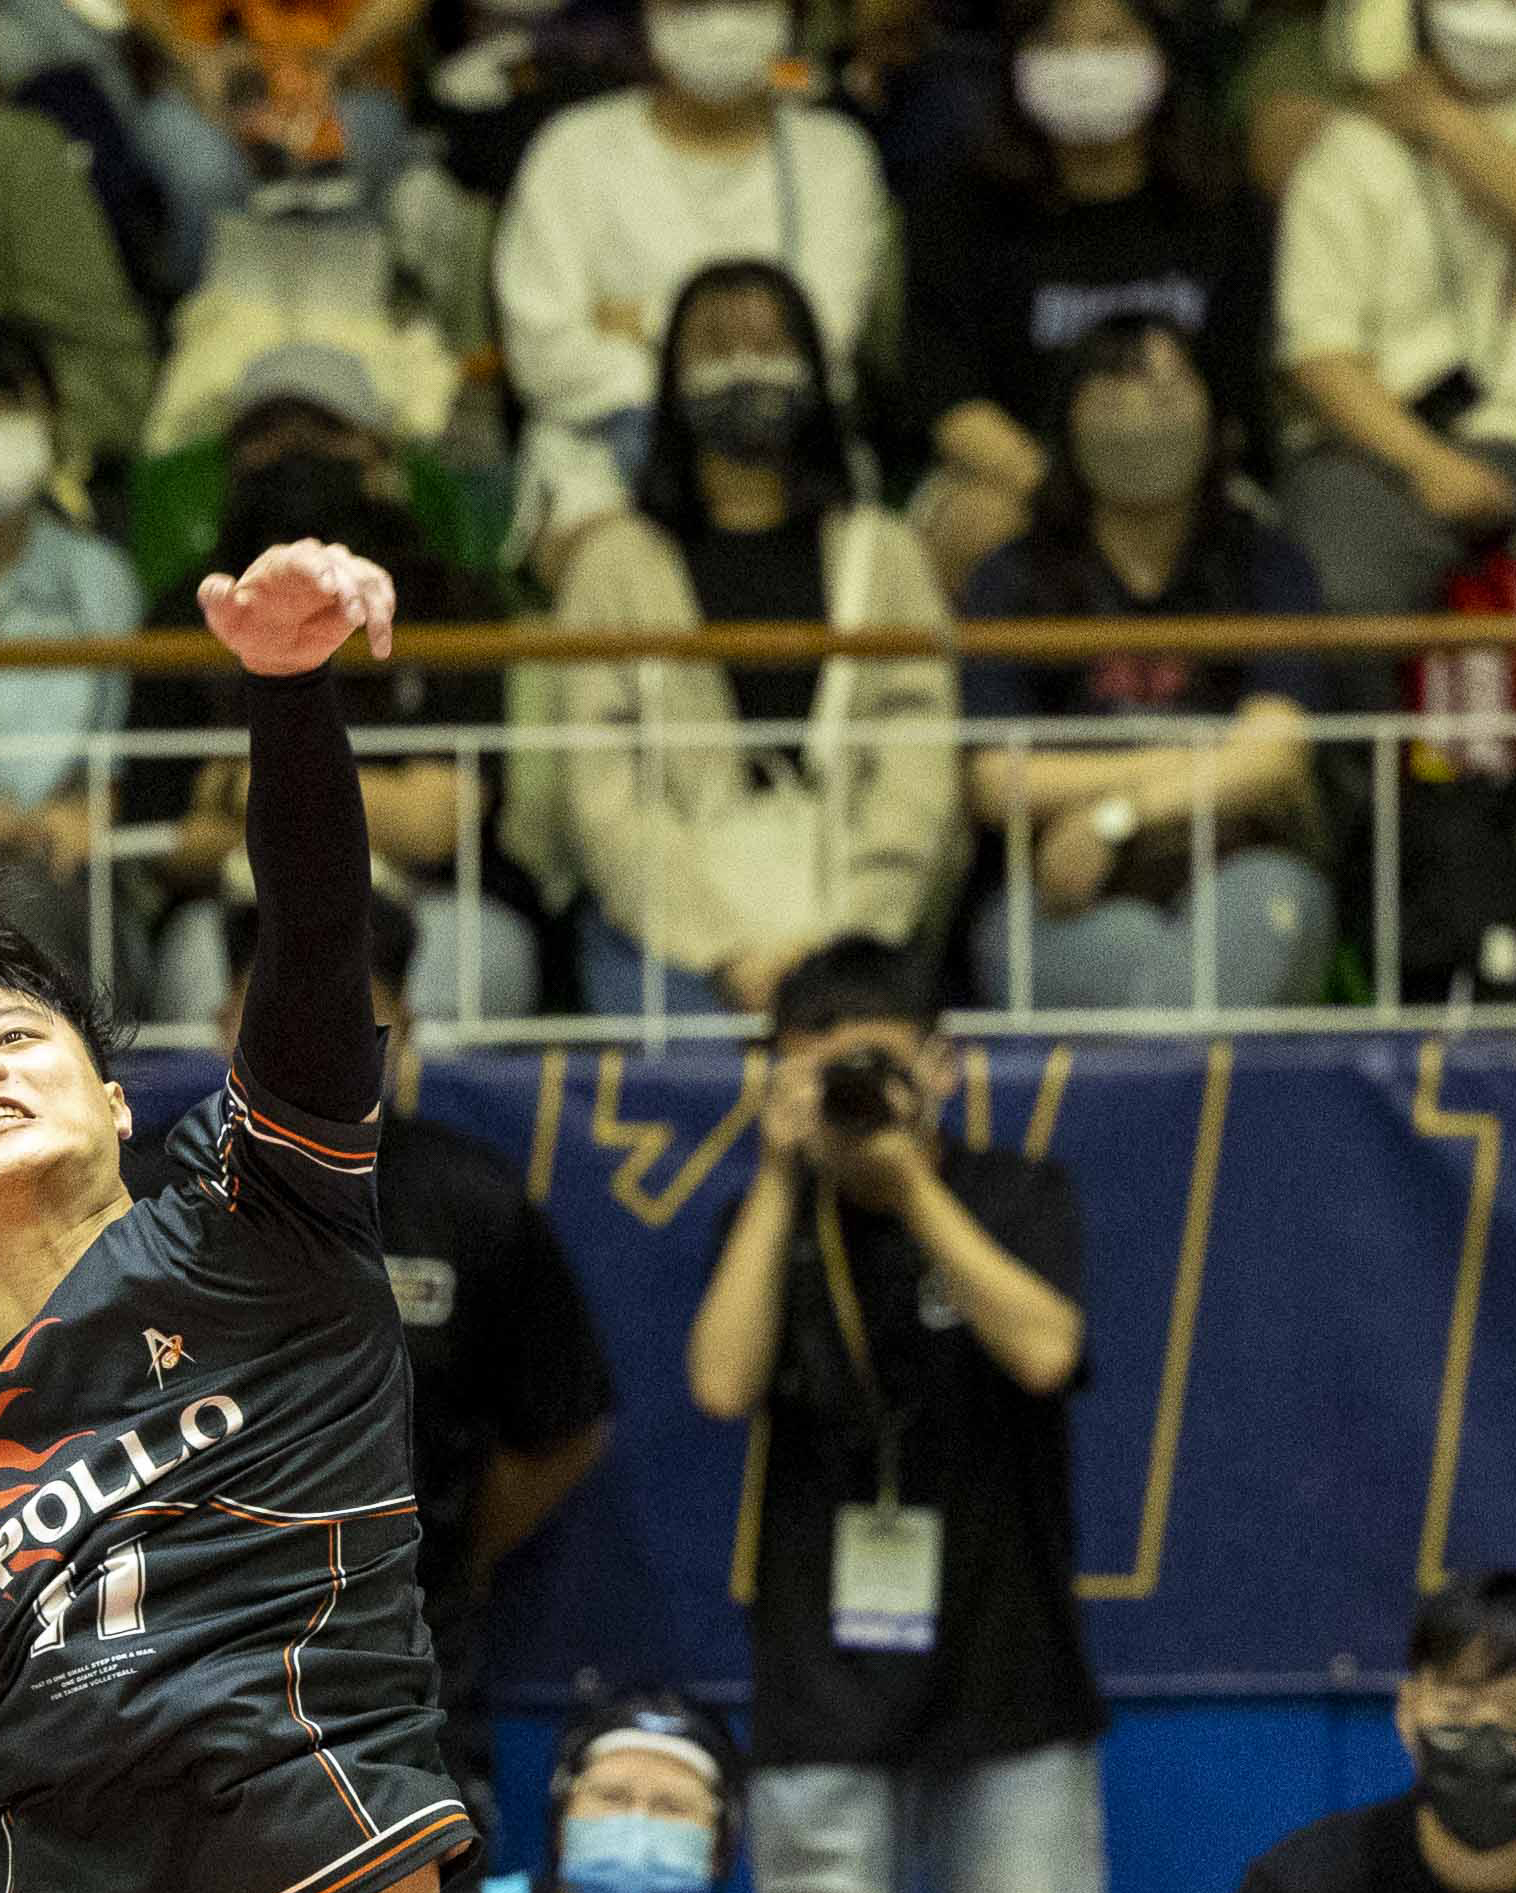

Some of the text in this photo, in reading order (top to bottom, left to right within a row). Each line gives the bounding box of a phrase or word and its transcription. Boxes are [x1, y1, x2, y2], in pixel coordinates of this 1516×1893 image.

[67, 1665, 90, 1677] SMALL
[90, 1658, 110, 1669] STEP
[111, 1653, 128, 1662] FOR
[99, 1663, 119, 1674] LEAP
